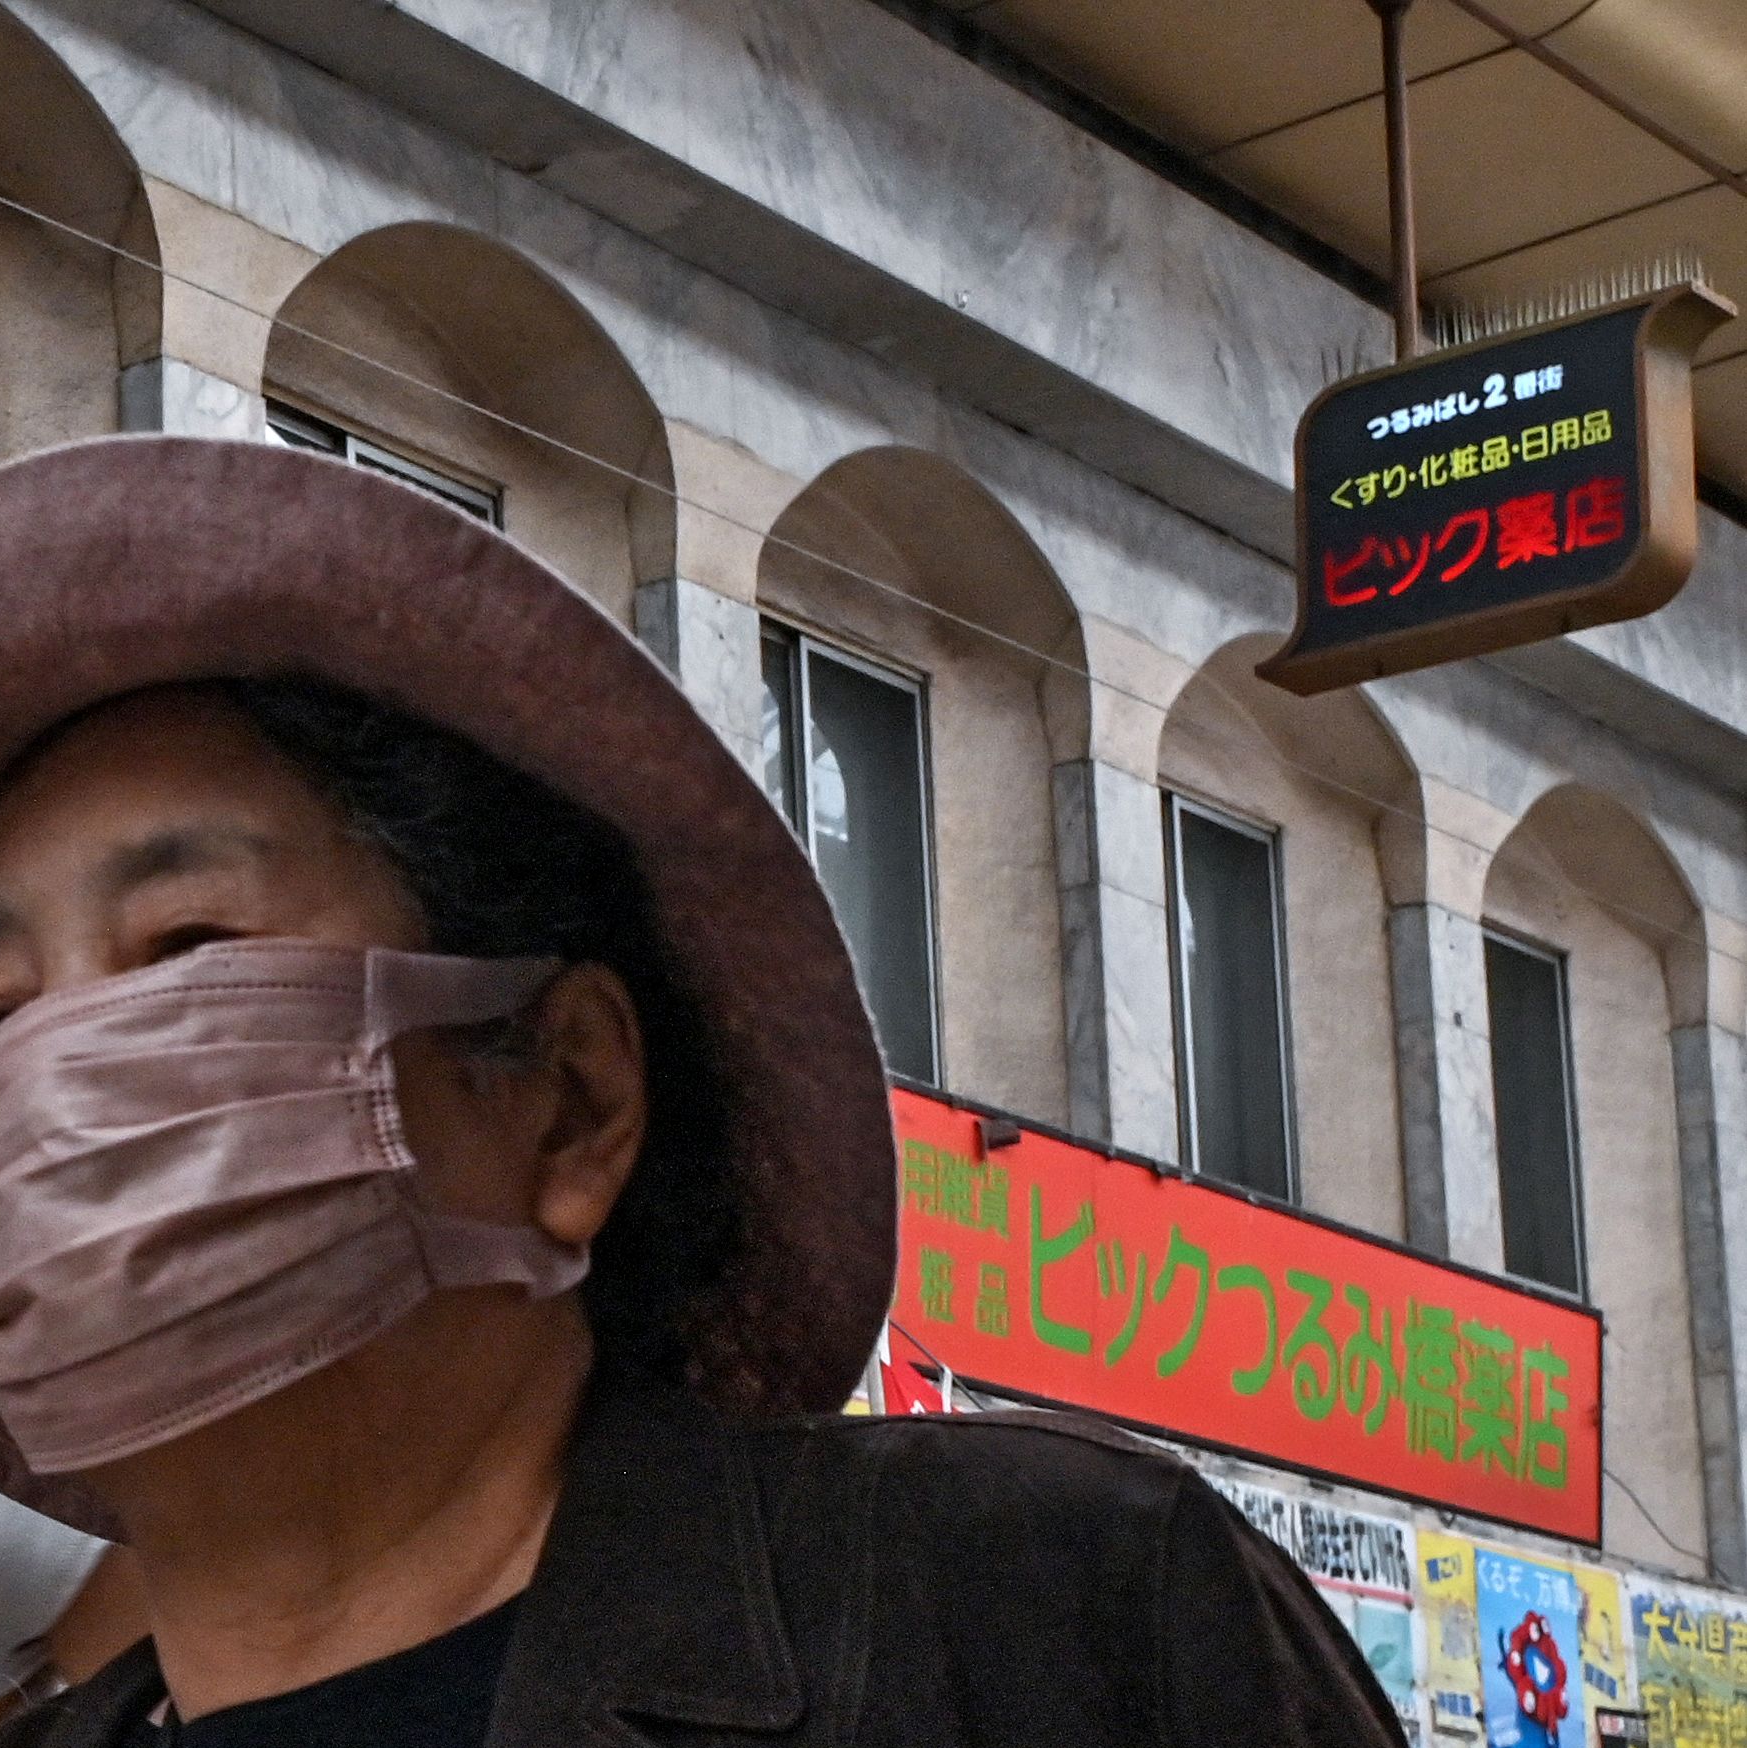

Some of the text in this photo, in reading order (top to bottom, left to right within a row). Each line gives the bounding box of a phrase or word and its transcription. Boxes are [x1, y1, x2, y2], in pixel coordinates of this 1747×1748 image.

[1329, 409, 1613, 510] くすり・化粧品・日用品
[1028, 1184, 1570, 1490] ビックつるみ橋薬店
